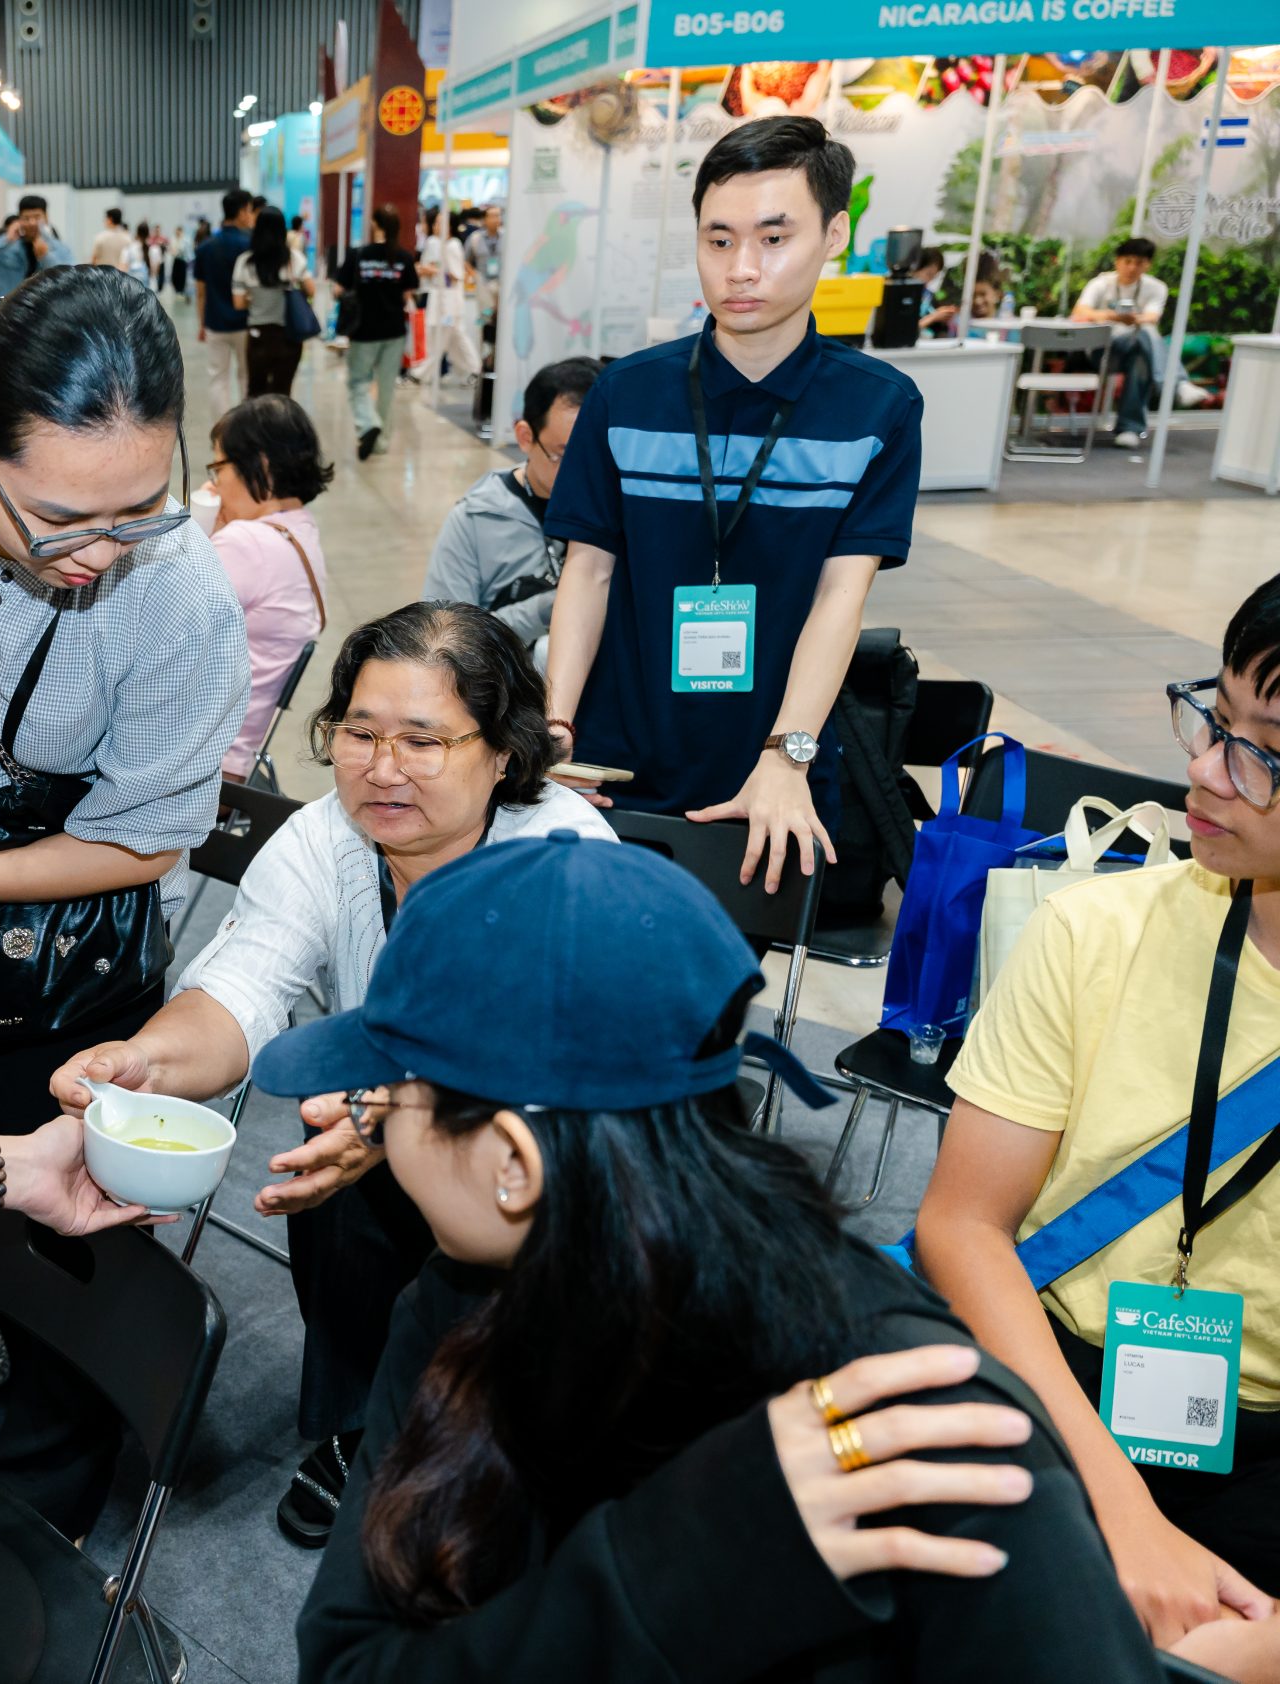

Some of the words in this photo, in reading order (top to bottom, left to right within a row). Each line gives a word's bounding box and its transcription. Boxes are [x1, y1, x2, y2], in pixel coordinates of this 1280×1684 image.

[673, 9, 785, 37] B05-B06
[878, 1, 1035, 28] NICARAGUA
[1041, 0, 1066, 21] IS
[1072, 0, 1176, 20] COFFEE
[690, 680, 734, 690] VISITOR
[1142, 1329, 1172, 1337] VIETNAM
[1143, 1311, 1233, 1337] CafeShow
[1127, 1446, 1200, 1468] VISITOR
